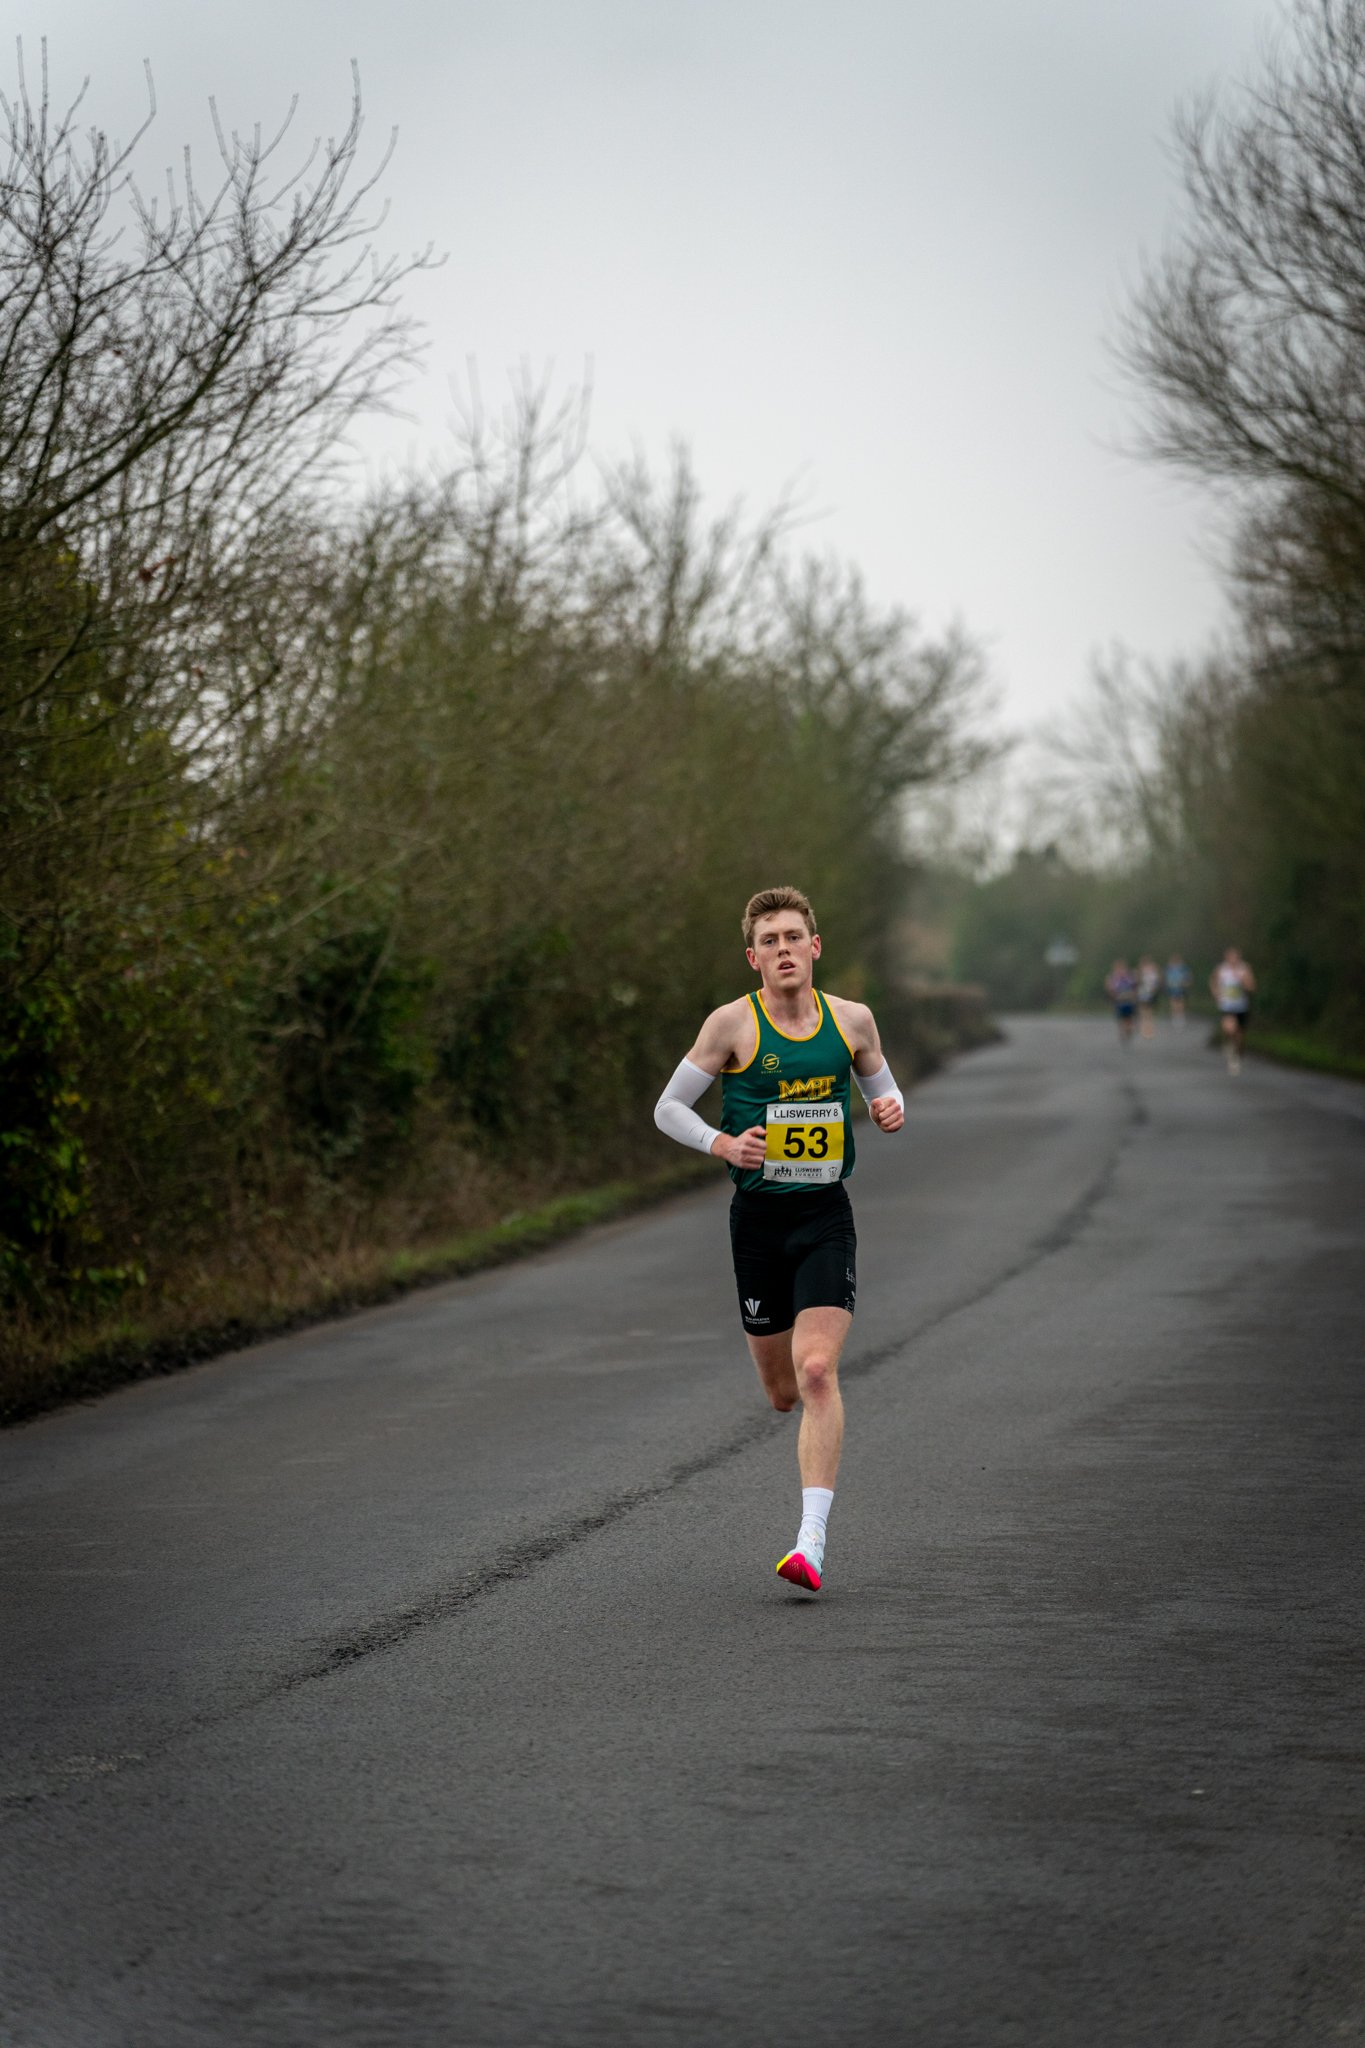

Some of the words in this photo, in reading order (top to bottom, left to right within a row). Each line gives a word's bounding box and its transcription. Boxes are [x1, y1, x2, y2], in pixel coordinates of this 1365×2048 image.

[774, 1109, 831, 1118] LLISWERRY
[833, 1108, 839, 1117] 8
[783, 1126, 829, 1158] 53
